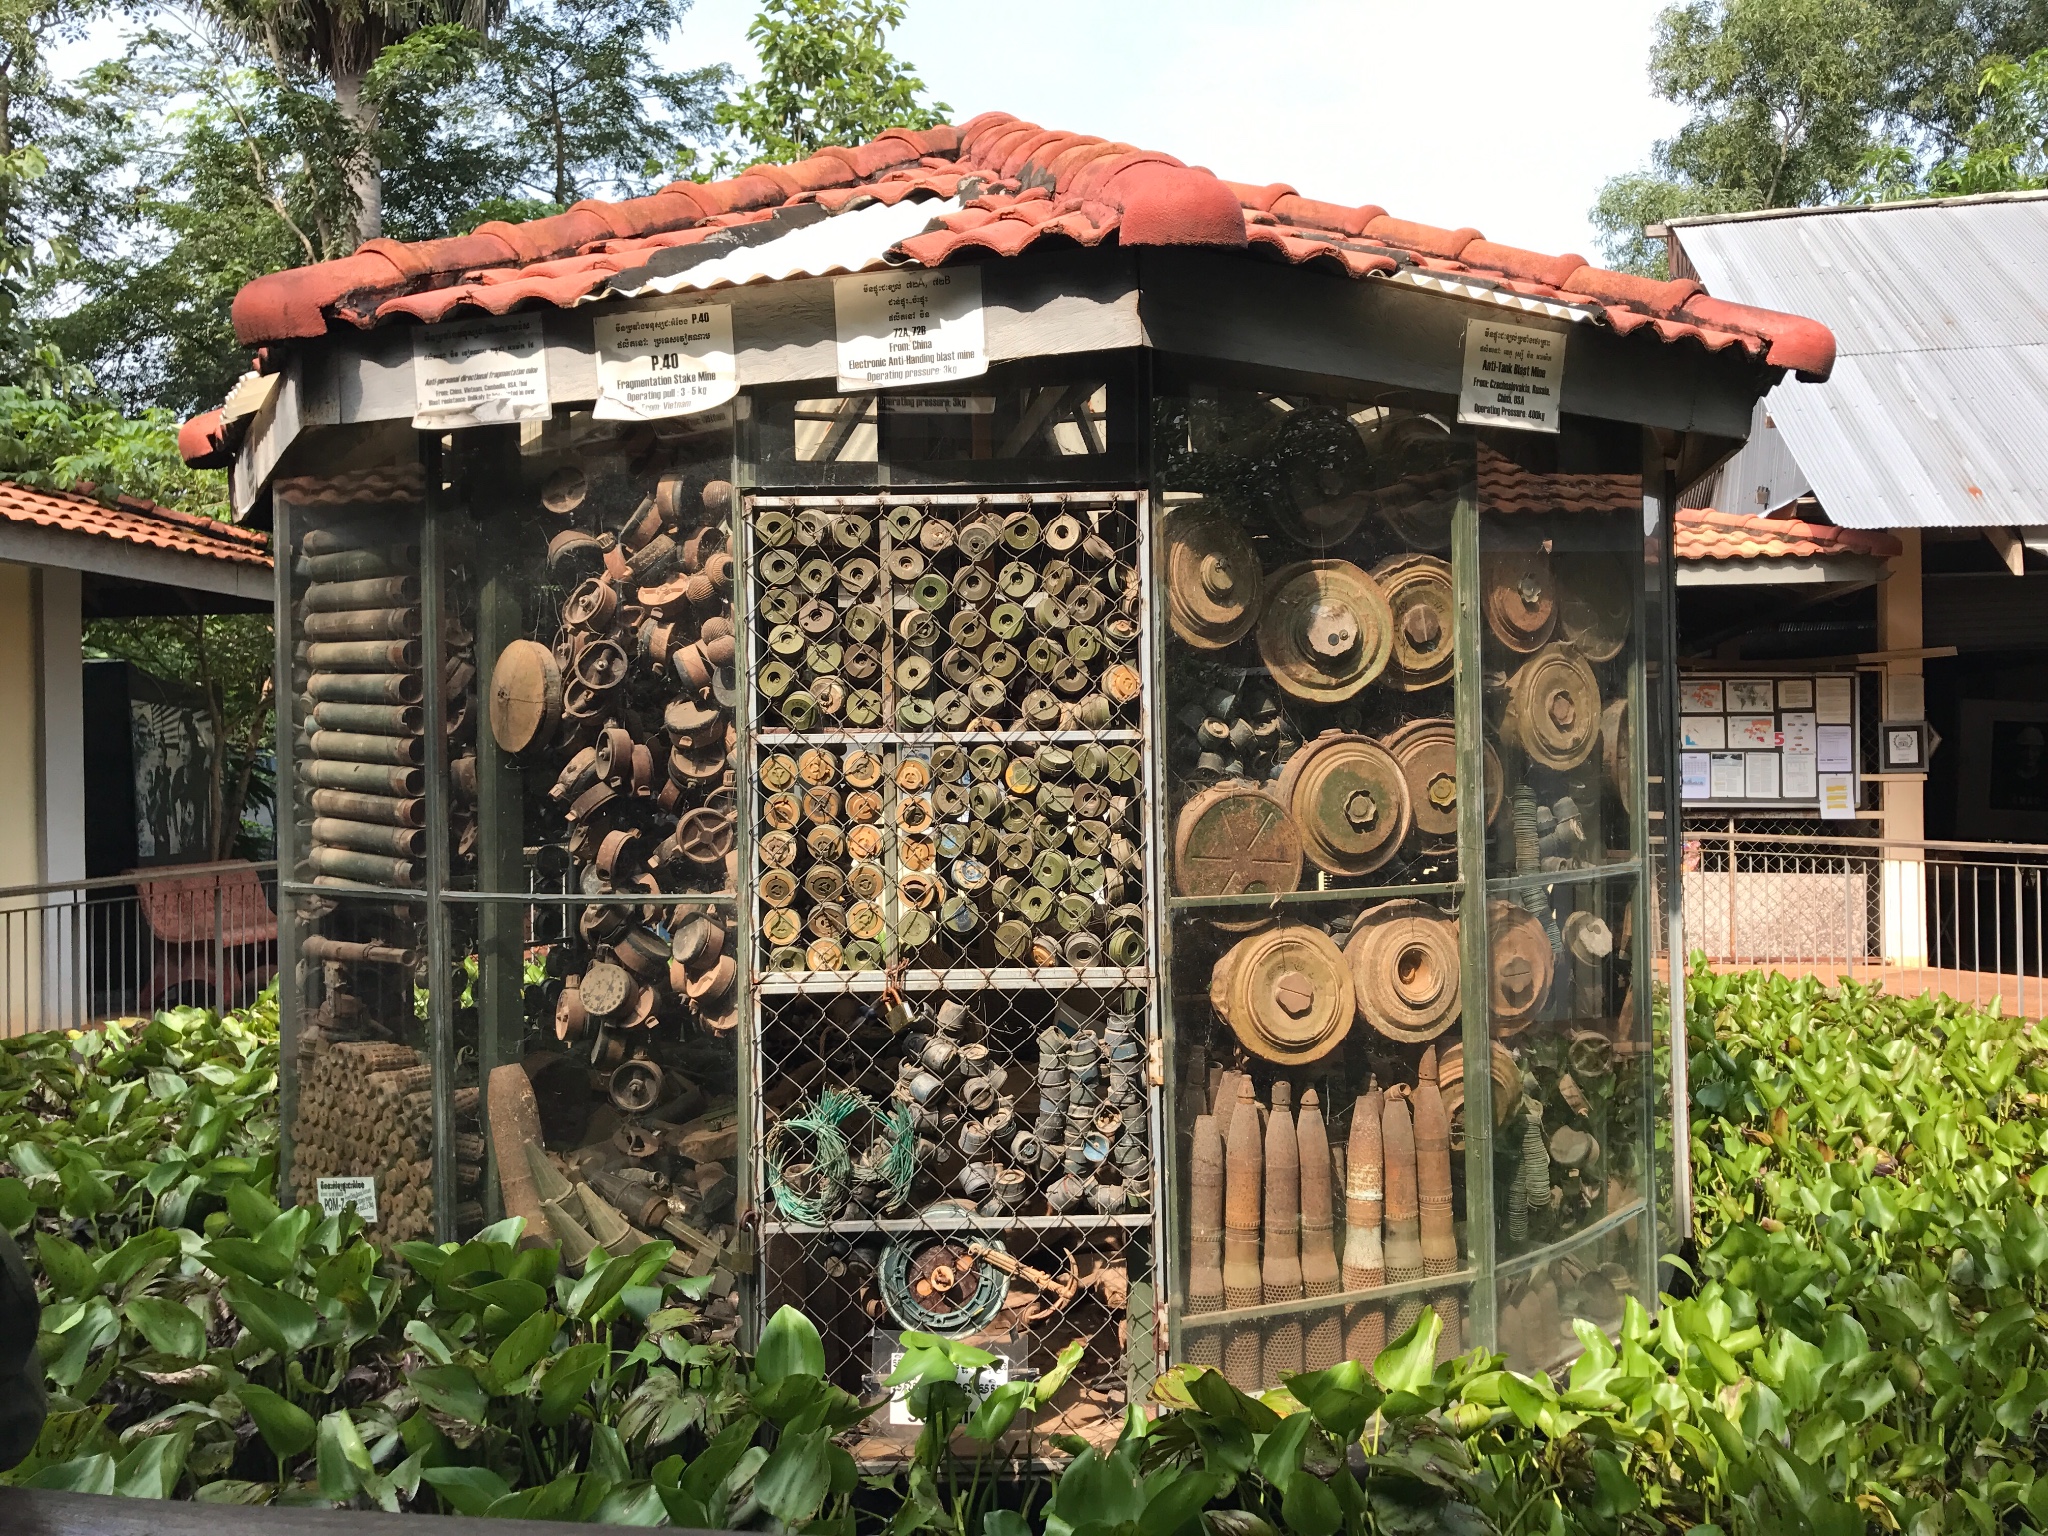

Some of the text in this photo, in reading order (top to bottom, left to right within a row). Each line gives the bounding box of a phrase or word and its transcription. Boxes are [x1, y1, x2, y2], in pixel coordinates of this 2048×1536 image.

[691, 312, 710, 324] P.40
[893, 326, 926, 339] 72A, 72B
[889, 340, 932, 352] From: China
[651, 352, 679, 371] P.40
[849, 350, 975, 370] Electronic Anti-Handing blast mine
[460, 372, 488, 382] directional
[489, 368, 525, 380] fragmentation
[866, 370, 903, 382] Operating
[943, 365, 957, 375] 3kg
[1482, 360, 1546, 378] Anti-Tank Blast Mine
[617, 371, 716, 390] Fragmentation Stake Mine
[1473, 377, 1489, 388] From:
[1490, 379, 1530, 394] Czechoslovakia,
[627, 390, 662, 402] Operating
[663, 389, 676, 399] pull
[680, 388, 686, 396] 3
[691, 387, 696, 395] 5
[698, 386, 707, 396] kg
[1497, 393, 1524, 406] China, USA
[663, 400, 692, 410] Vietnam
[952, 399, 966, 408] 3kg
[1474, 403, 1501, 416] Operating
[1528, 410, 1545, 422] 400kg
